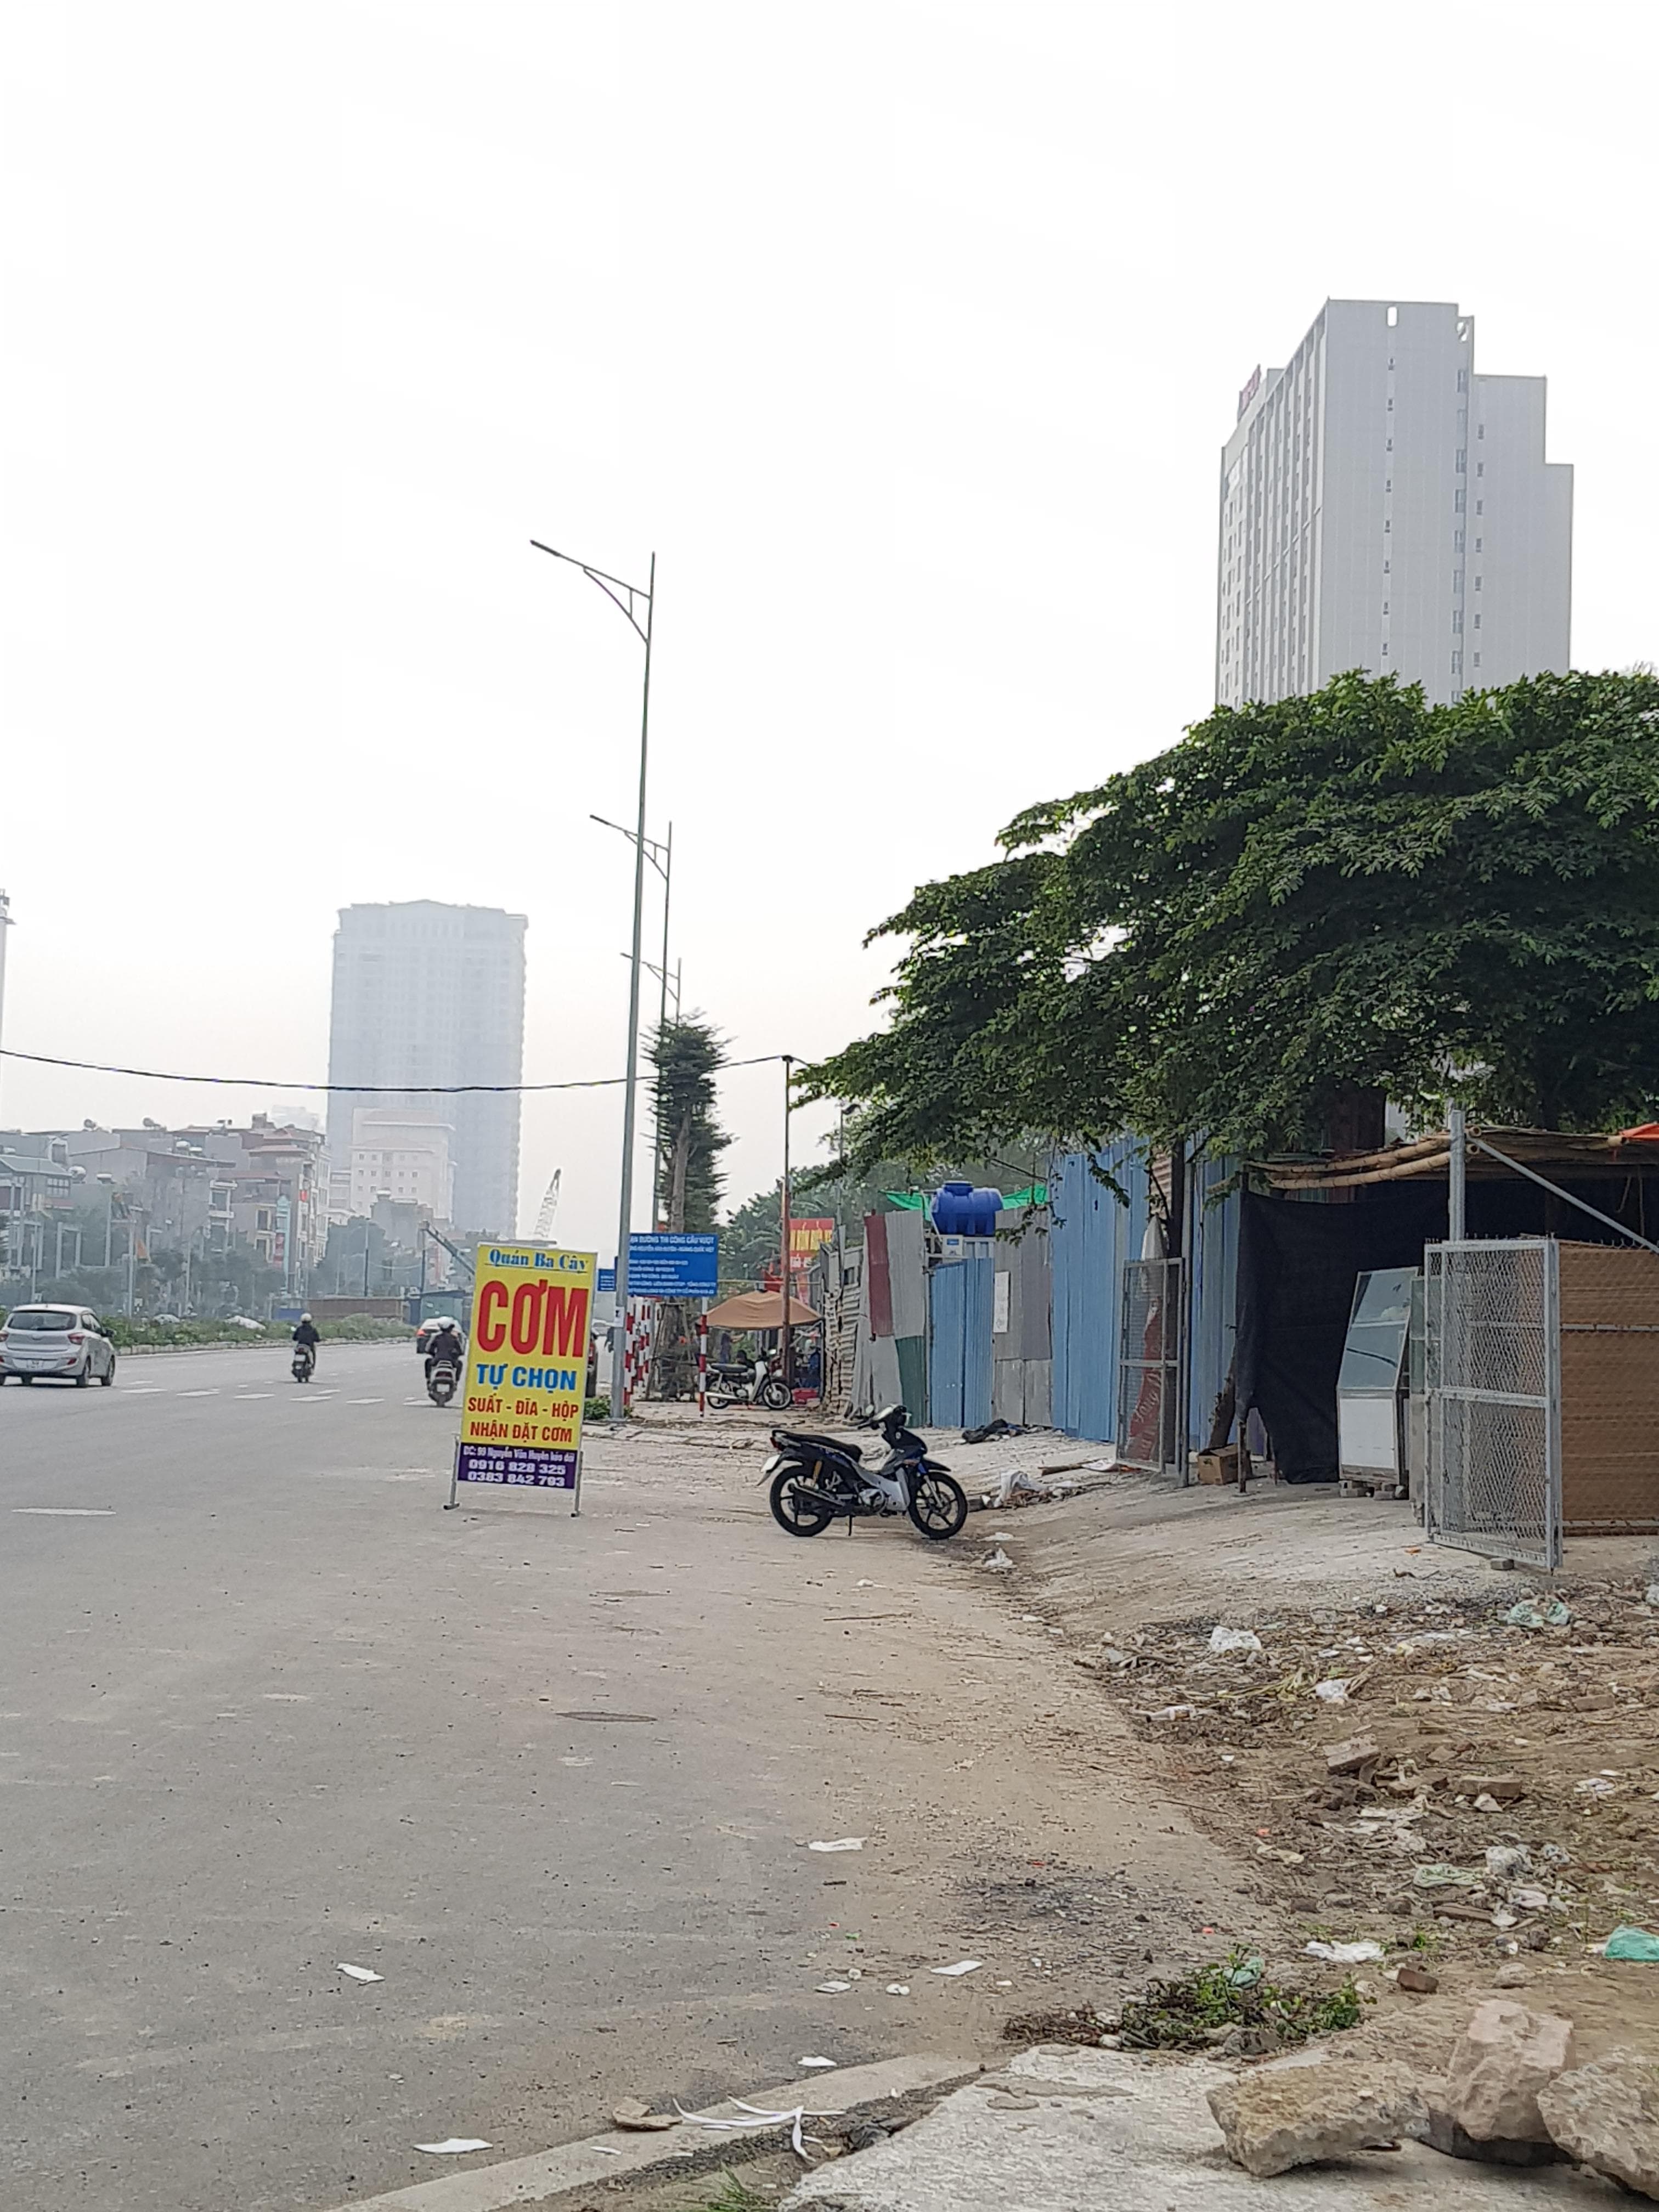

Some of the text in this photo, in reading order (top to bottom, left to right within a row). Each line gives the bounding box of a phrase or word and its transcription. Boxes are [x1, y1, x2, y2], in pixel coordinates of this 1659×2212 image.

[490, 1249, 528, 1266] Quán
[534, 1252, 554, 1267] Ba
[477, 1279, 589, 1357] CƠM
[476, 1363, 577, 1393] TỰ CHỌN
[468, 1393, 503, 1413] SUẤT
[516, 1397, 538, 1416] ĐĨA
[551, 1400, 579, 1421] HỘP
[470, 1419, 572, 1443] NHẬN ĐẶT CƠM
[467, 1471, 504, 1482] 0383
[507, 1473, 535, 1485] 842
[469, 1459, 505, 1470] 0916
[539, 1464, 566, 1475] 325
